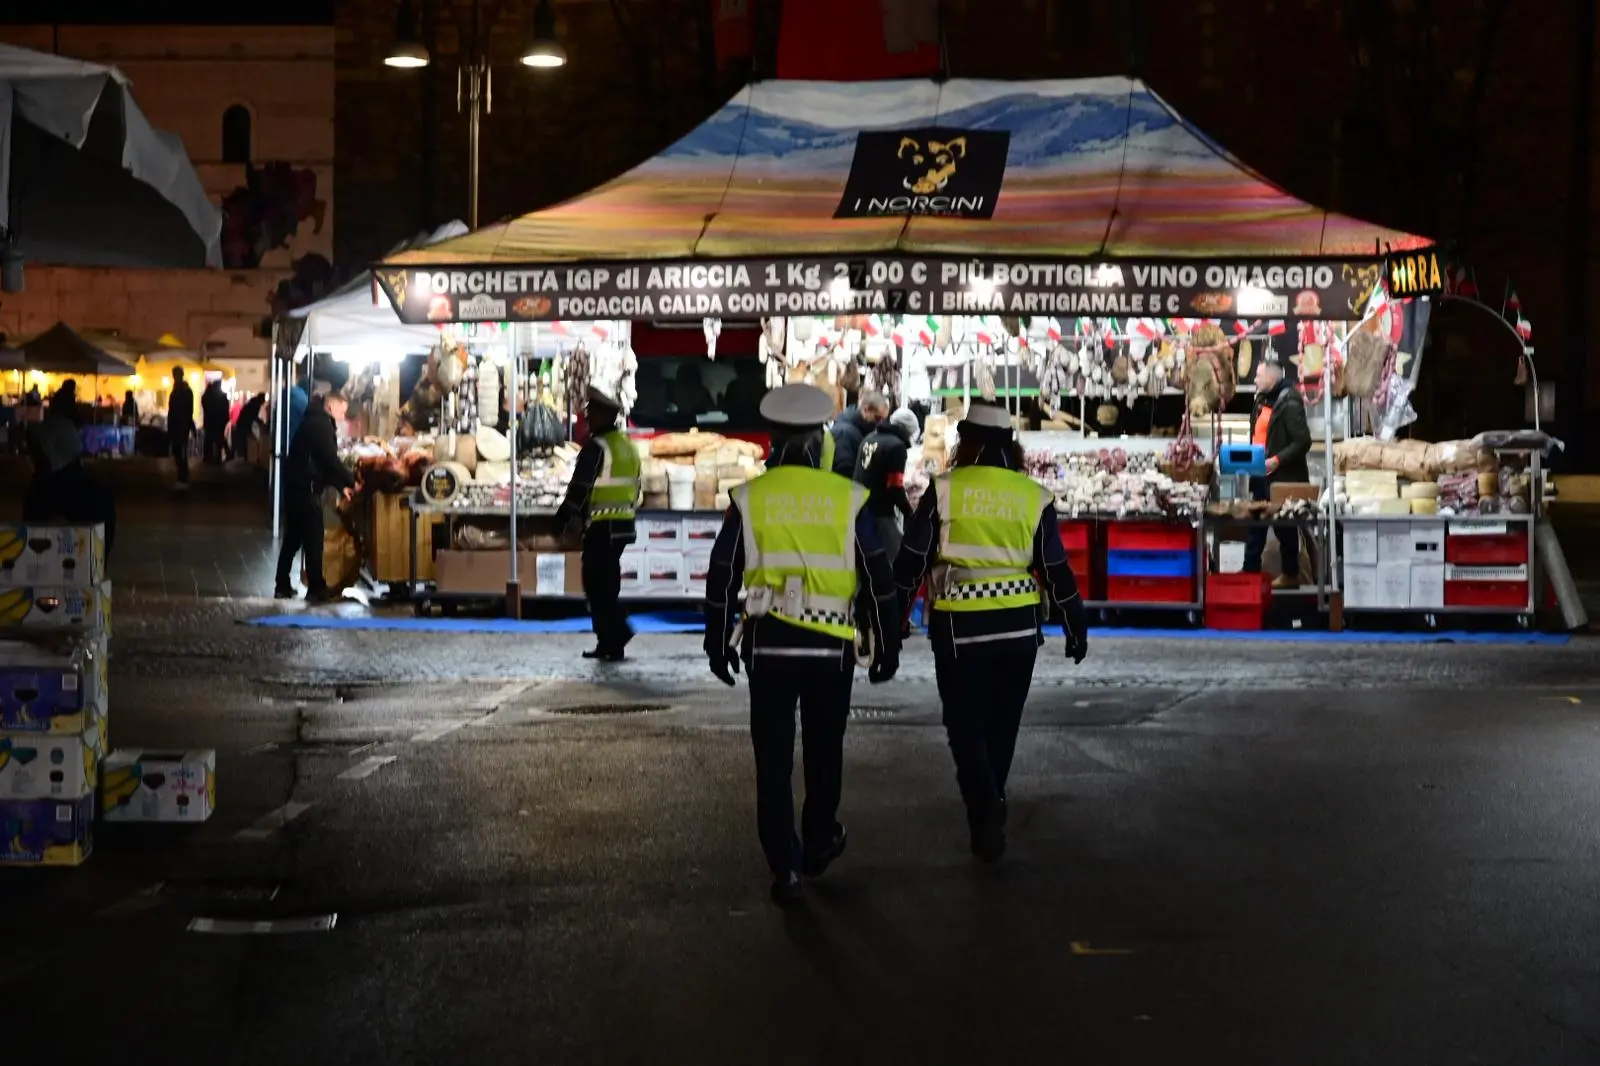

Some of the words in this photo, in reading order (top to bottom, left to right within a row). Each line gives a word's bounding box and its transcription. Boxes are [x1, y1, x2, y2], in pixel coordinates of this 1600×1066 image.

[868, 195, 984, 212] NORCINI
[415, 270, 560, 293] PORCHETTA
[567, 270, 610, 290] IGP
[617, 268, 639, 288] di
[646, 265, 751, 288] ARICCIA
[765, 265, 781, 286] 1
[787, 265, 822, 289] Kg
[992, 263, 1125, 288] BOTTIGLIA
[1132, 266, 1198, 287] VINO
[1205, 266, 1334, 288] OMAGGIO
[558, 296, 654, 315] FOCACCIA
[659, 294, 724, 314] CALDA
[728, 293, 770, 311] CON
[775, 291, 886, 311] PORCHETTA
[942, 292, 1006, 311] BIRRA
[1010, 292, 1144, 312] ARTIGIANALE
[1149, 294, 1161, 312] 5
[765, 493, 835, 510] POLIZIA
[764, 509, 835, 525] LOCALE
[962, 504, 1026, 521] LOCALE
